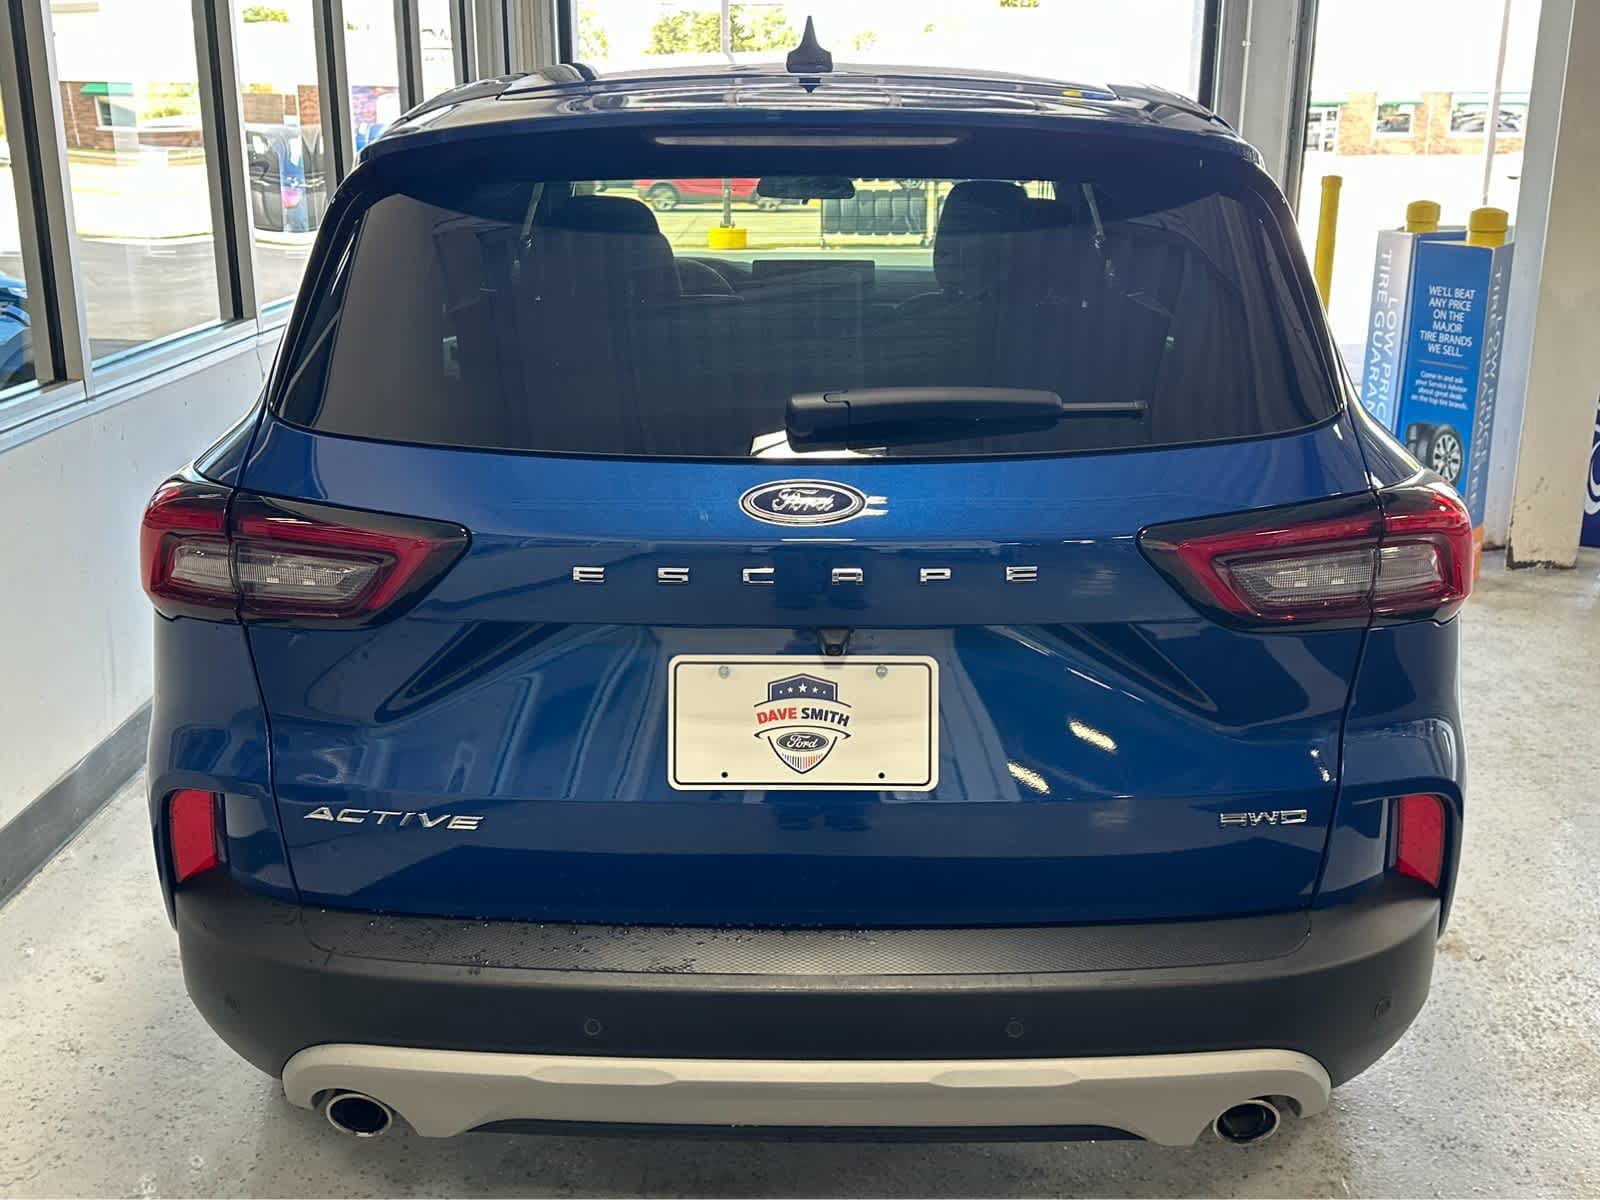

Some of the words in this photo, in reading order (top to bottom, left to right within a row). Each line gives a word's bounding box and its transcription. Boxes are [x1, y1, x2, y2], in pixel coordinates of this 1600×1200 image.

[1376, 248, 1393, 304] TIRE
[1429, 285, 1453, 297] WE'LL
[1454, 288, 1476, 299] BEAT
[1428, 297, 1447, 308] ANY
[1448, 299, 1472, 312] PRICE
[1433, 308, 1447, 320] ON
[1449, 310, 1464, 322] THE
[1383, 297, 1399, 358] LOW
[1433, 321, 1463, 333] MAJOR
[1420, 330, 1437, 341] TIRE
[1438, 333, 1473, 347] BRANDS
[1428, 343, 1441, 354] WE
[772, 487, 835, 511] Ford
[572, 566, 1038, 584] ESCAPE
[756, 706, 798, 725] DAVE
[800, 707, 850, 727] SMITH
[786, 733, 818, 748] Ford
[303, 806, 485, 831] ACTIVE
